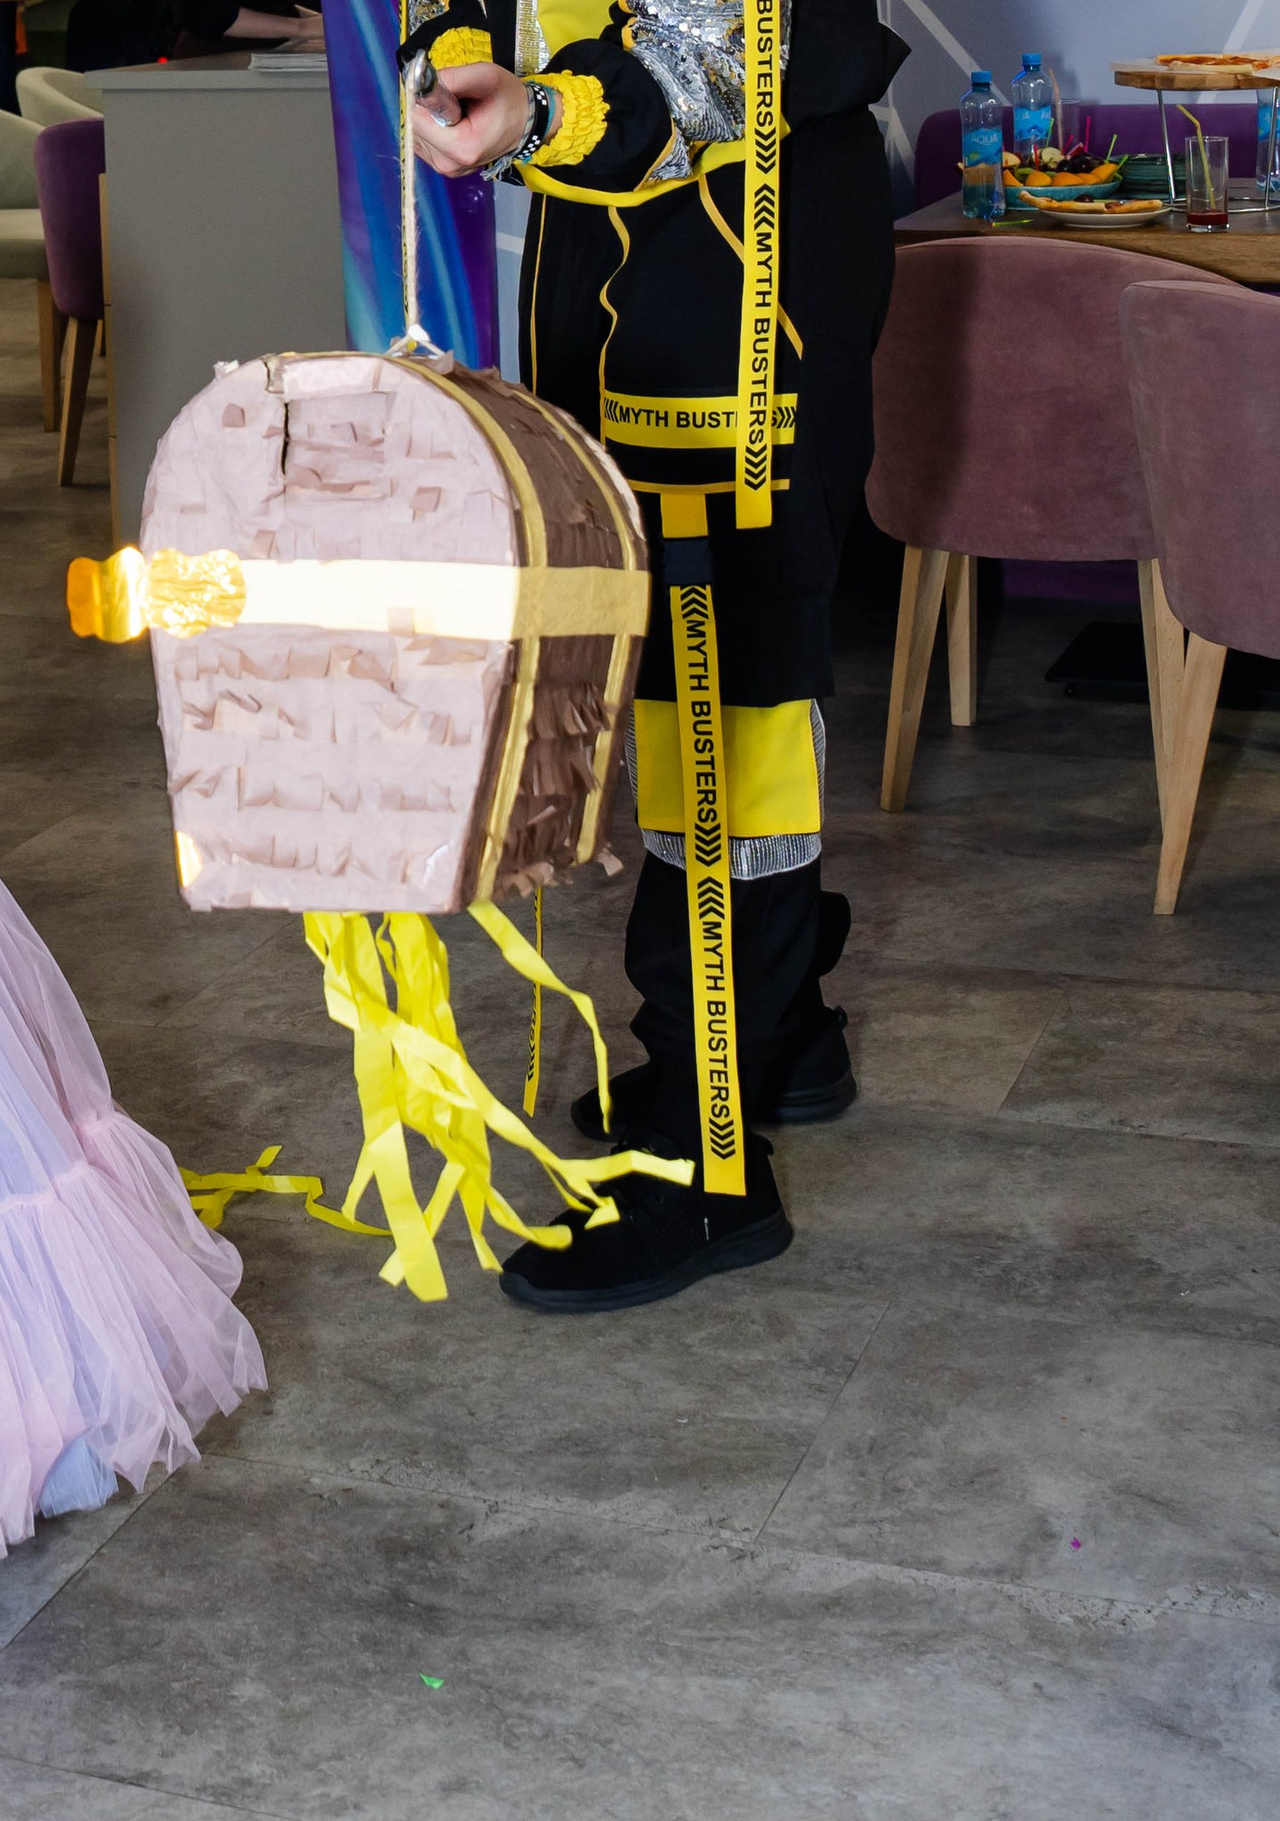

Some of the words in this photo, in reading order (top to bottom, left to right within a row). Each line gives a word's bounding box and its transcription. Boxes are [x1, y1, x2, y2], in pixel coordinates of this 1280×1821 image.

[754, 232, 772, 307] MYTH
[619, 409, 669, 427] MYTH
[749, 318, 771, 445] BUSTERS
[686, 620, 709, 691] MYTH
[691, 700, 718, 824] BUSTERS
[703, 921, 725, 991] MYTH
[706, 1000, 730, 1119] BUSTERS
